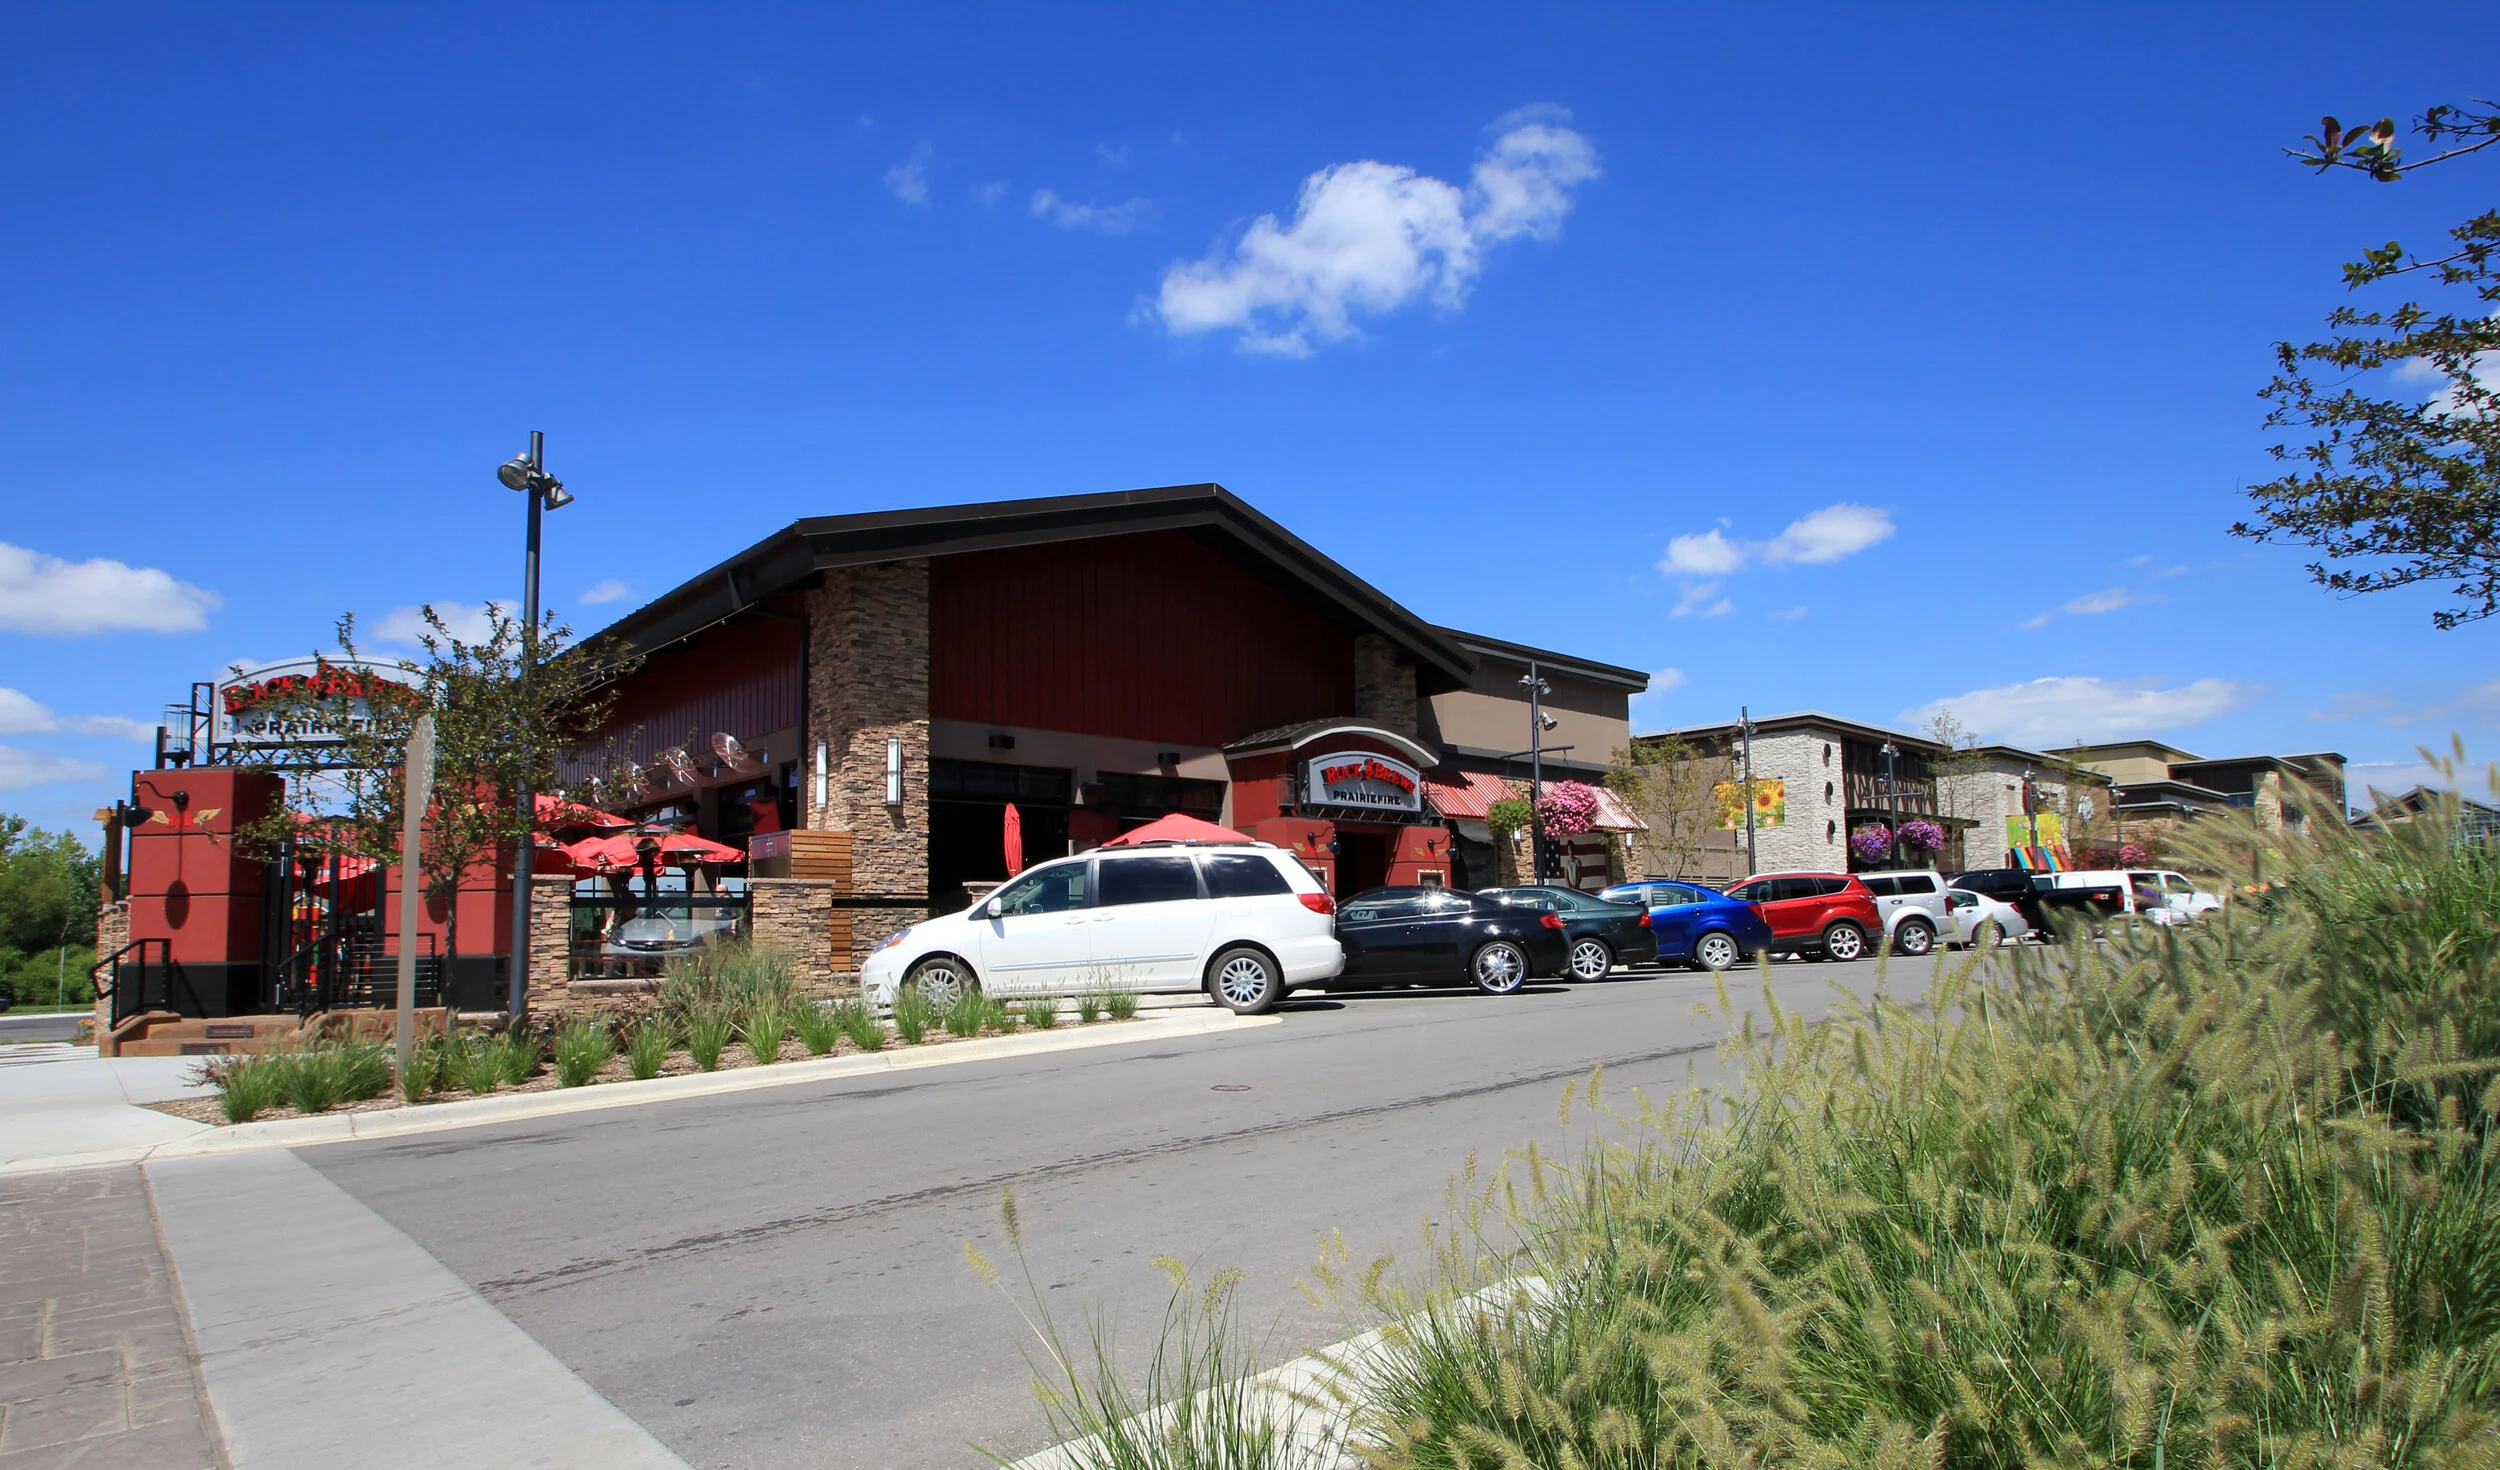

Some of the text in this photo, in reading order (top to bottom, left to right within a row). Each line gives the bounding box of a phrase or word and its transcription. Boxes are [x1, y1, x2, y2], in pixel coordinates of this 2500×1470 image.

[1325, 763, 1363, 785] ROCK
[1374, 762, 1417, 795] BREWS
[1332, 790, 1401, 805] PRAIRIEFIRE
